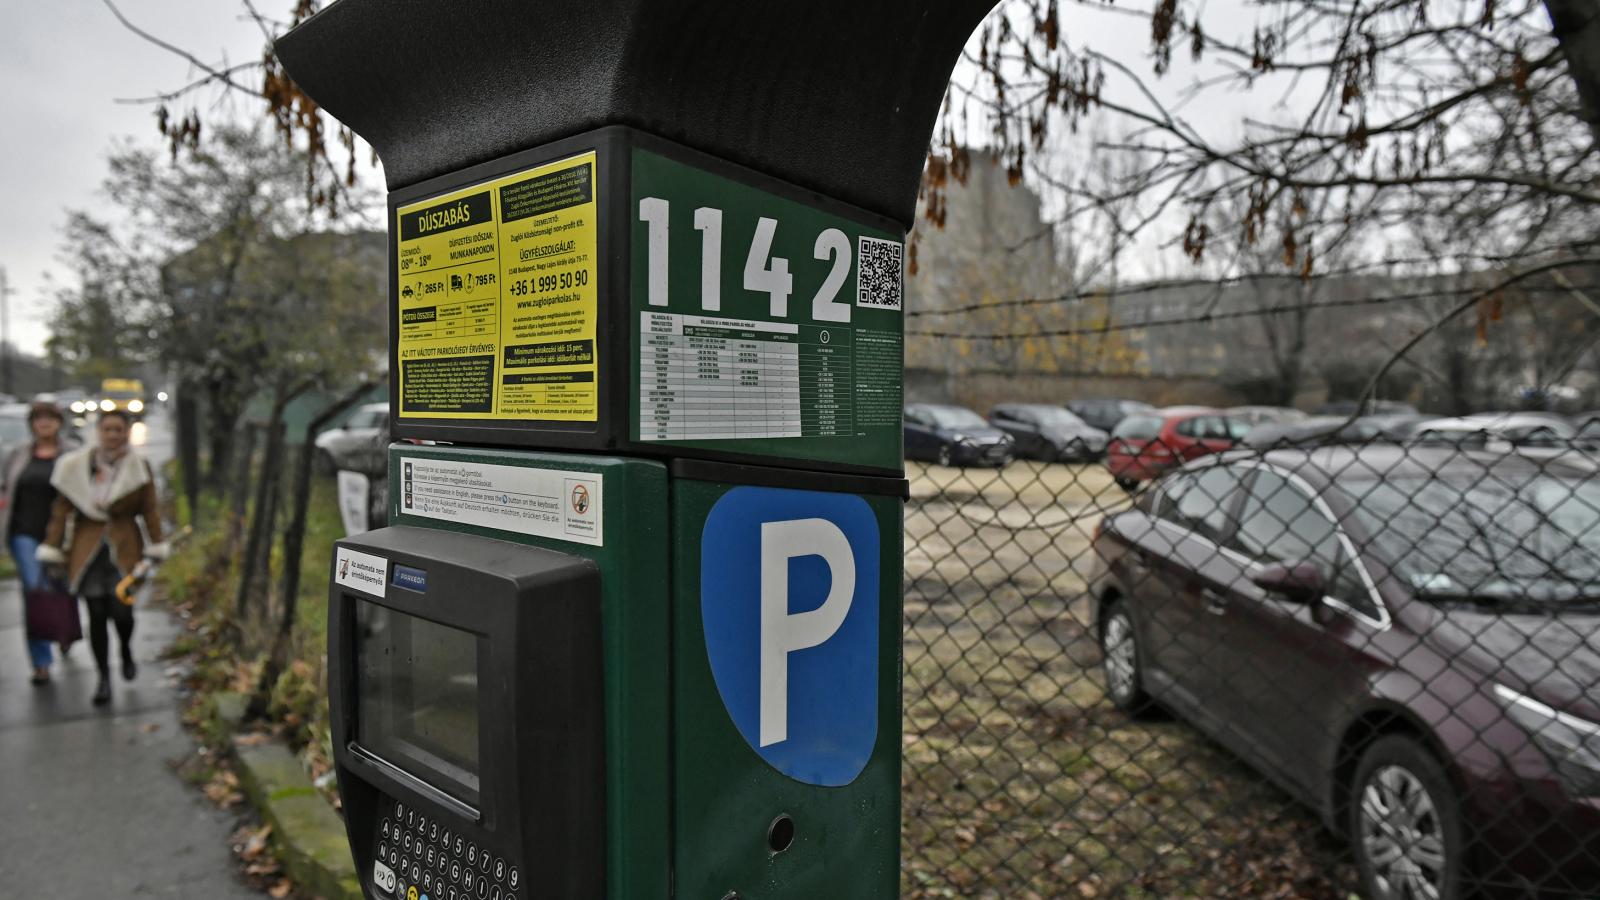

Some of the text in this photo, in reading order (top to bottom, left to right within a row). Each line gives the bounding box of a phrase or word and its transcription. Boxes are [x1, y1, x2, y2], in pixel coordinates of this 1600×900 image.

[419, 202, 470, 232] DÍJSZABÁS
[450, 244, 494, 260] MUNKANAPOKON
[520, 240, 576, 260] ÜGYFÉLSZOLGÁLAT:
[639, 197, 852, 323] 1142
[438, 282, 444, 292] Ft
[489, 273, 496, 284] Ft
[510, 269, 588, 296] +36 1 999 50 90
[517, 292, 580, 309] www.zugloiparkolas.hu
[417, 347, 436, 357] VÁLTOTT
[469, 343, 496, 353] ÉRVÉNYES:
[465, 503, 481, 511] Deutsch
[538, 500, 560, 510] keyboard.
[356, 563, 375, 572] automata
[351, 570, 383, 586] érintőképernyős
[760, 518, 856, 748] P
[397, 804, 518, 886] 0 1 2 3 4 5 6 7 8 9
[383, 822, 388, 834] A
[394, 829, 399, 840] B
[405, 836, 410, 847] C
[416, 843, 422, 854] D
[427, 850, 434, 863] E
[440, 857, 446, 869] F
[452, 865, 458, 879] G
[465, 873, 472, 888] H
[480, 882, 483, 894] I
[380, 845, 386, 857] N
[402, 858, 407, 870] P
[412, 866, 419, 880] Q
[424, 874, 431, 887] R
[437, 882, 442, 895] S
[450, 890, 455, 900] T
